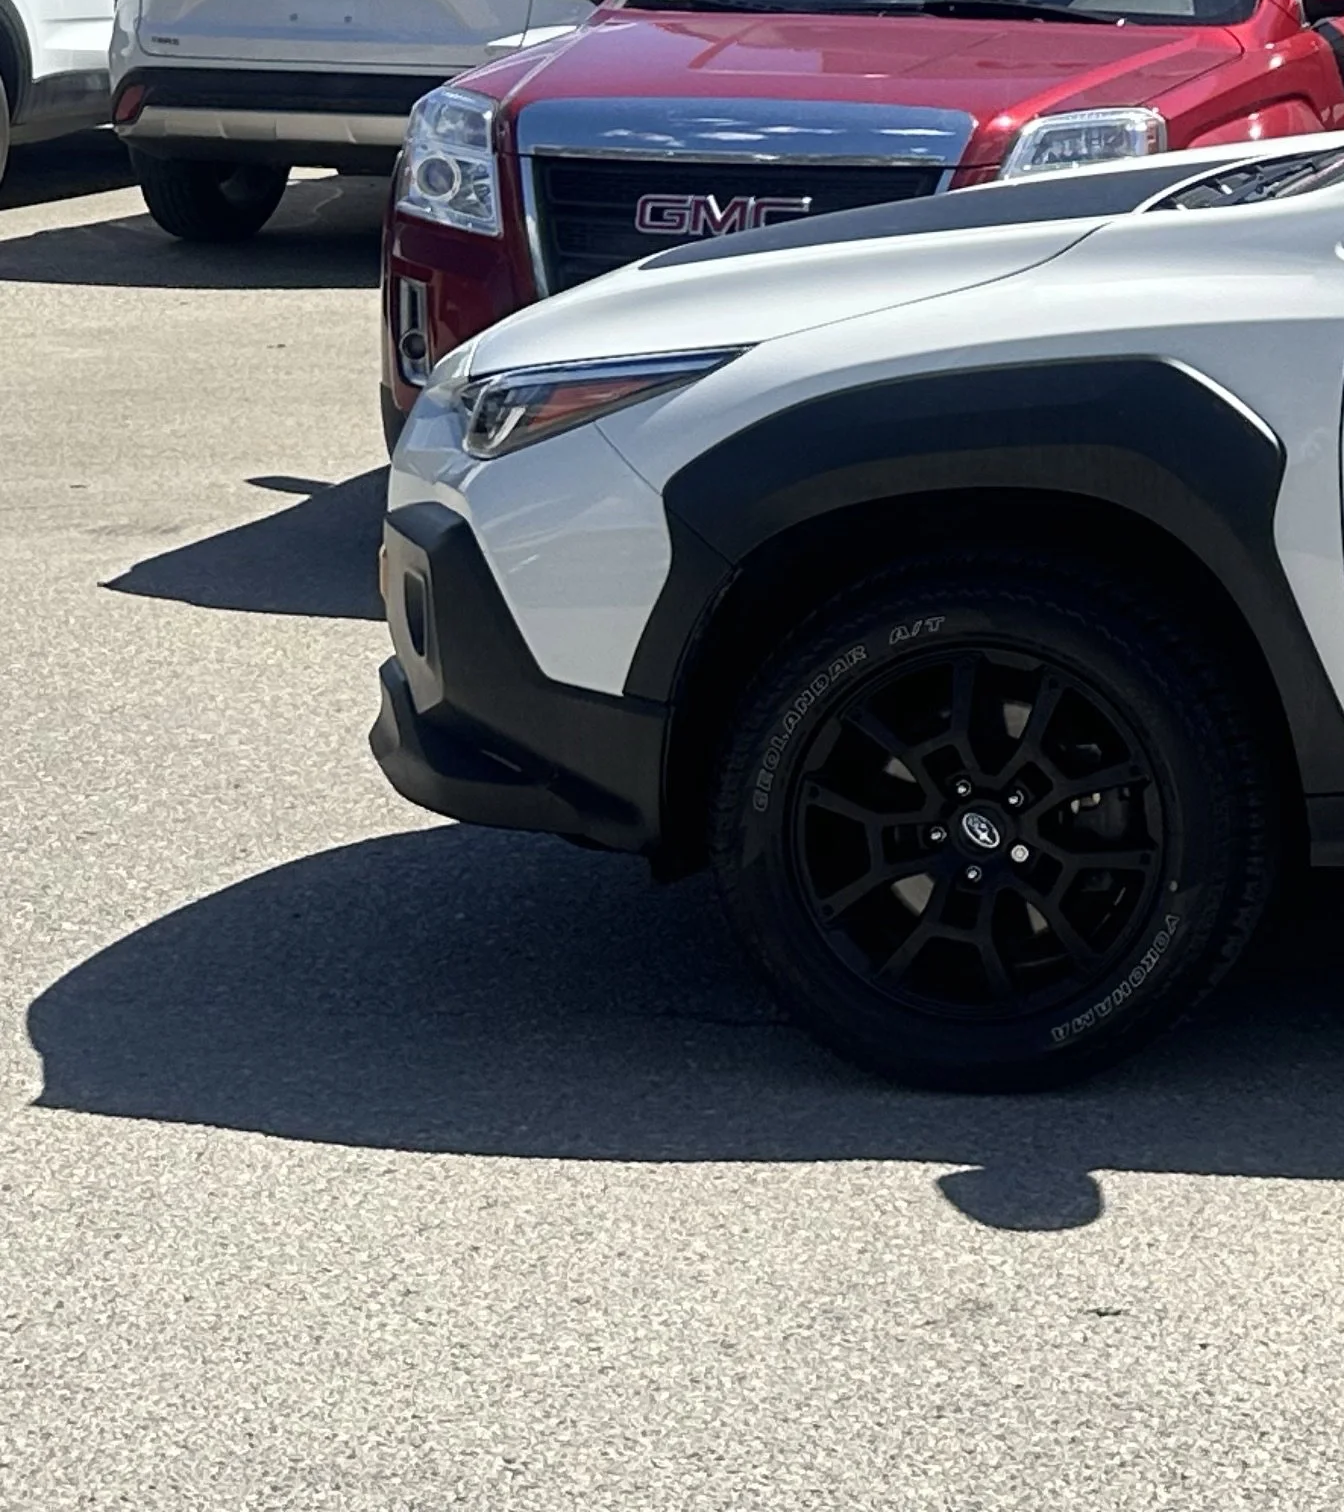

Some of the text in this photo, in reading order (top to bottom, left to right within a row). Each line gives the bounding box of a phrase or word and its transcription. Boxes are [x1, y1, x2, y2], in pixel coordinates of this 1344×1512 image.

[753, 615, 946, 812] GEOLANDAR A/T
[1050, 914, 1180, 1043] YOKOHAMA
